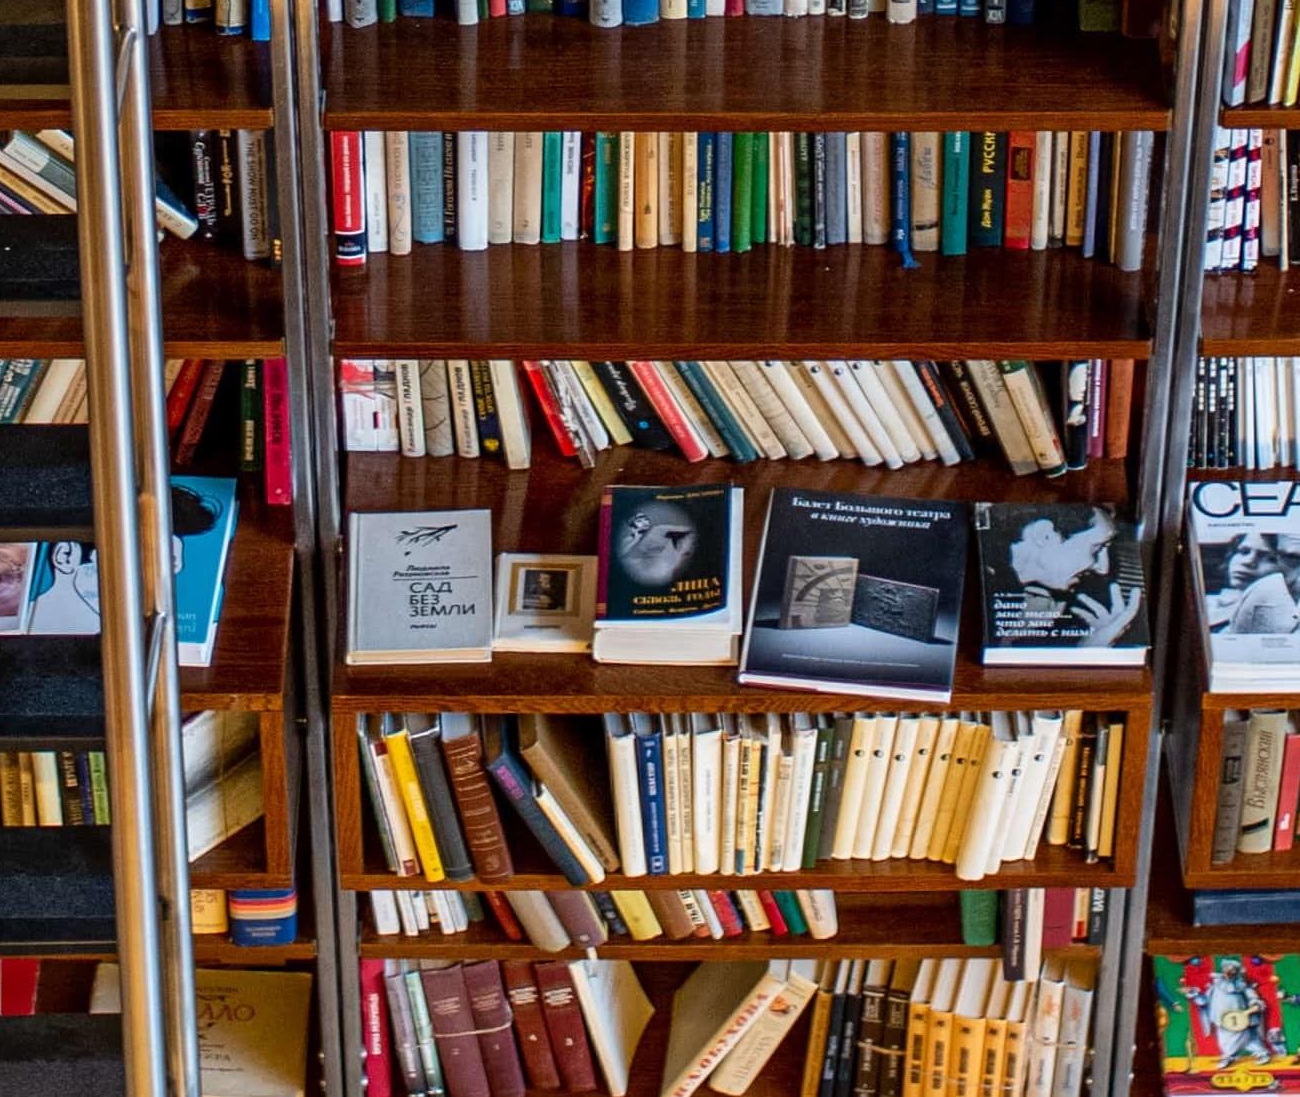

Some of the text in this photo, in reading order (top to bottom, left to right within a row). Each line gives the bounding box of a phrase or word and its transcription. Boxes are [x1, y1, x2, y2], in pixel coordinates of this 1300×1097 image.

[981, 209, 992, 227] Дон
[792, 496, 952, 522] Балет Большого театра
[821, 514, 858, 525] книге
[859, 516, 931, 530] художника
[409, 581, 453, 595] САД
[670, 576, 721, 592] ЛИЦА
[409, 594, 441, 606] БЕЗ
[994, 599, 1028, 611] дано
[409, 603, 477, 618] ЗЕМЛИ
[1026, 618, 1055, 627] мне
[994, 627, 1046, 639] делать
